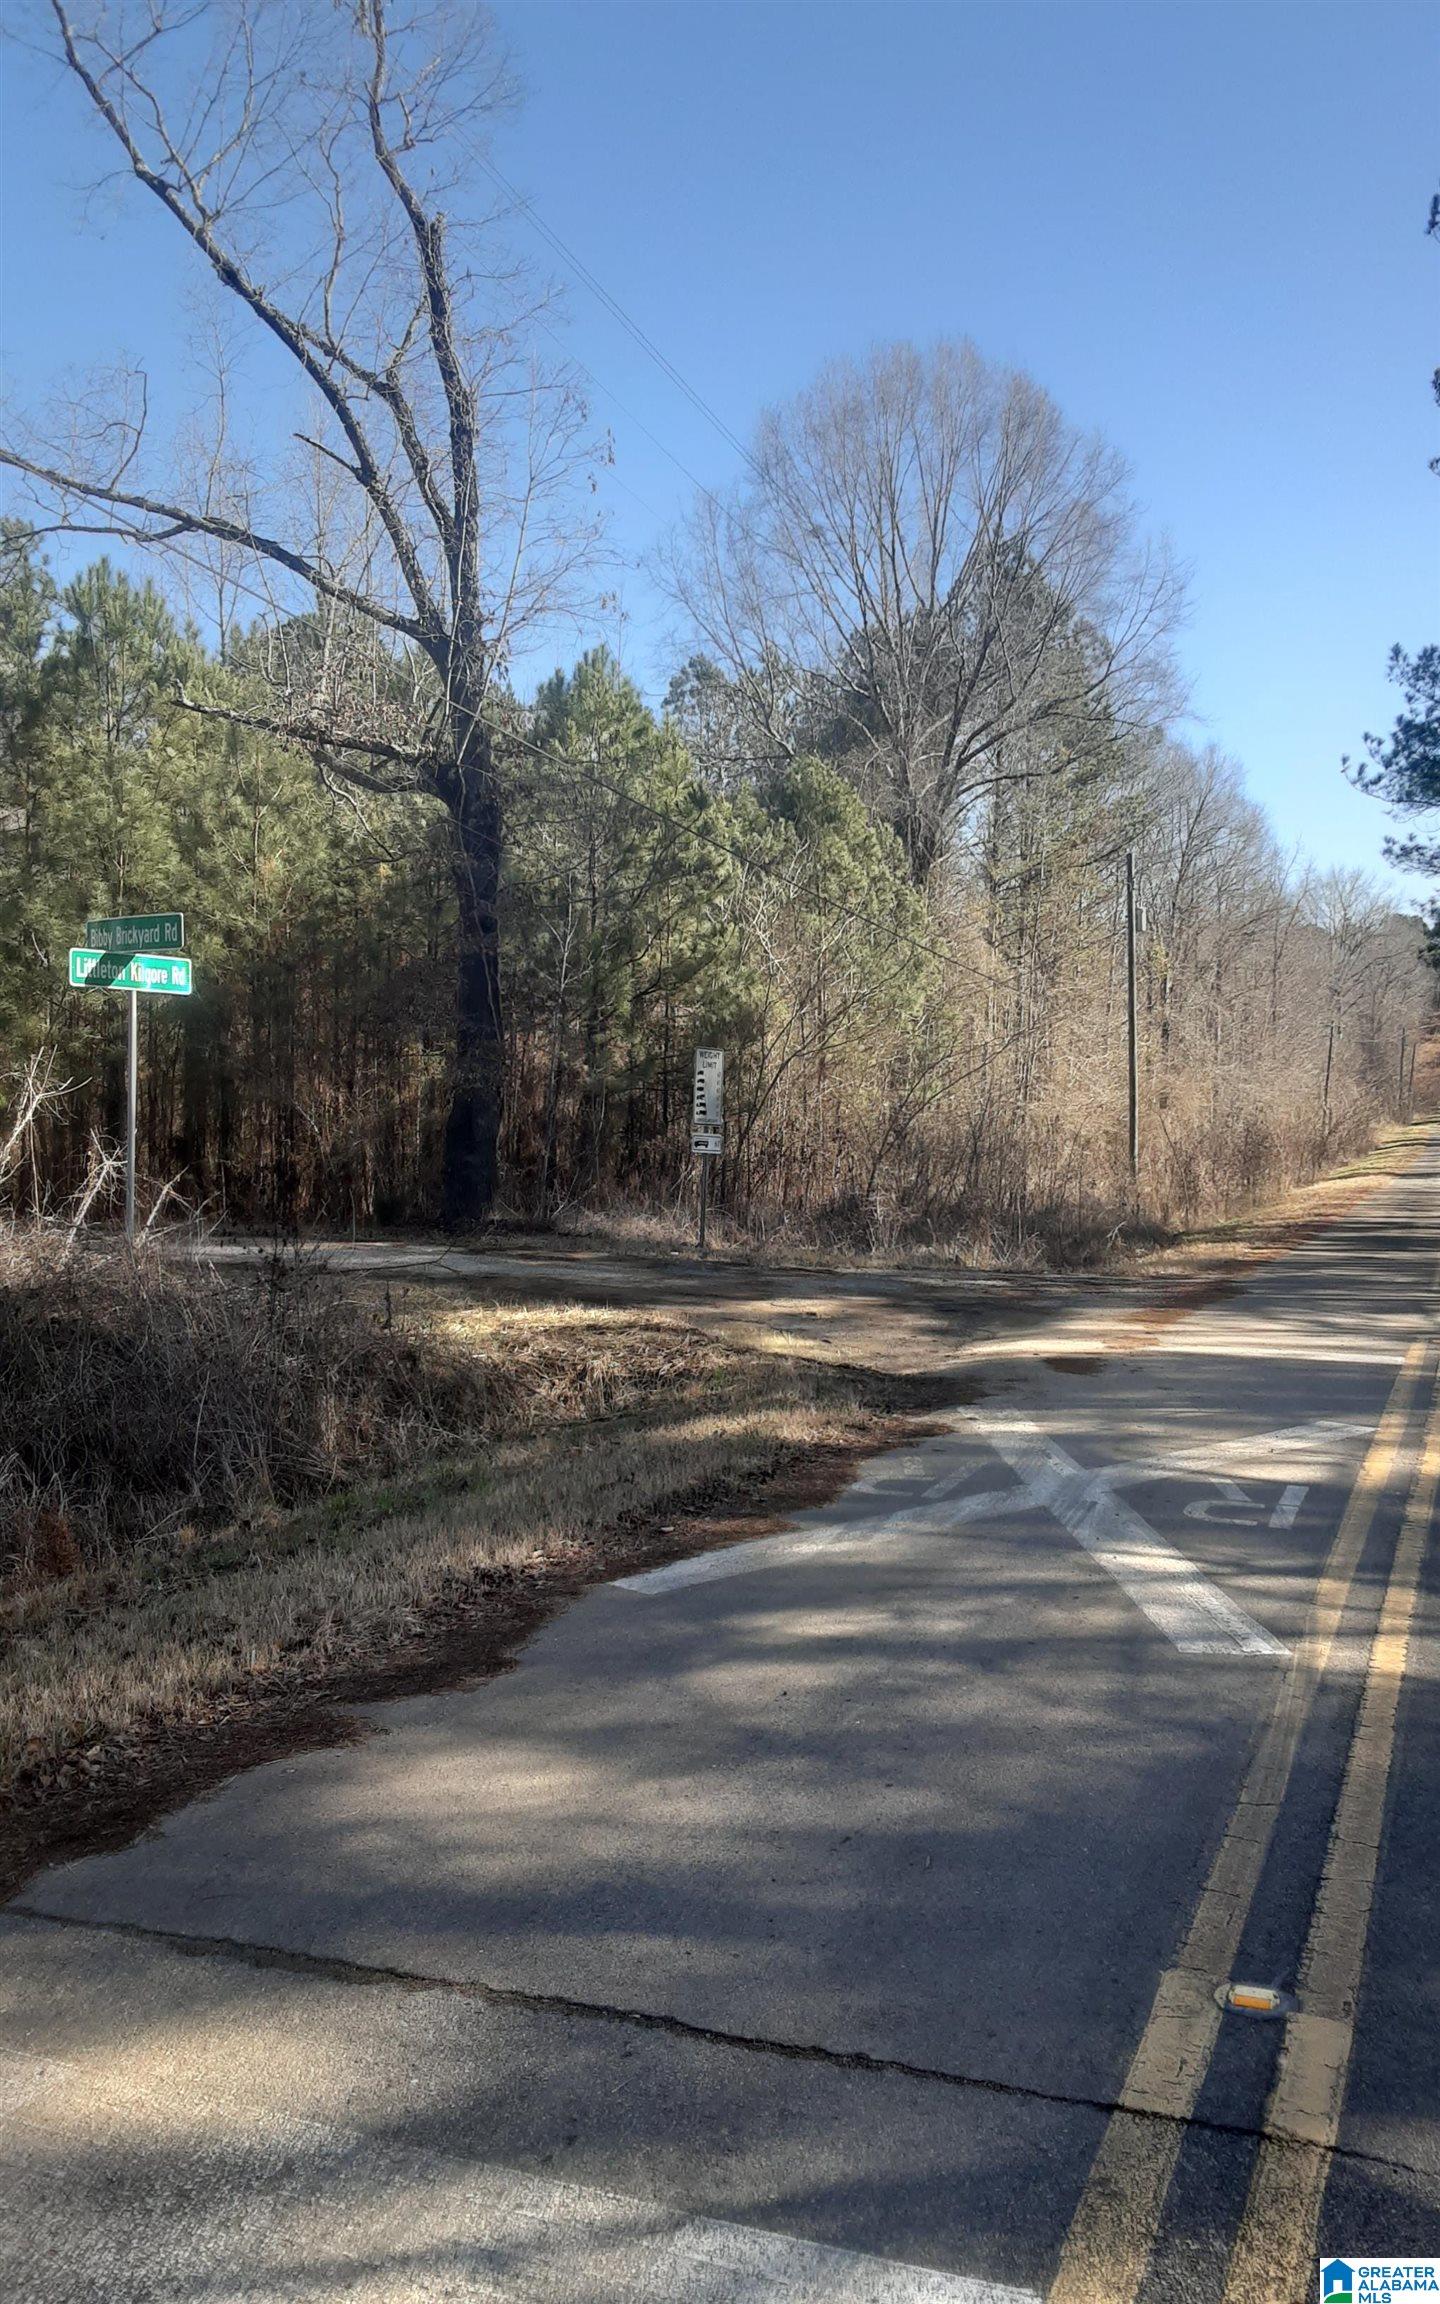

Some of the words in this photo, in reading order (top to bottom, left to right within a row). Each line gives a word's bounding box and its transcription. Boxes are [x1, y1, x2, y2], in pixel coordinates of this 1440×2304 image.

[90, 928, 113, 949] Bibby
[115, 924, 160, 948] Brickyard
[164, 923, 178, 942] Rd
[76, 956, 126, 981] Littleton
[129, 961, 169, 989] Kilgore
[171, 965, 187, 985] Rd
[699, 1050, 721, 1060] WEIGHT
[702, 1061, 717, 1069] LIMIT
